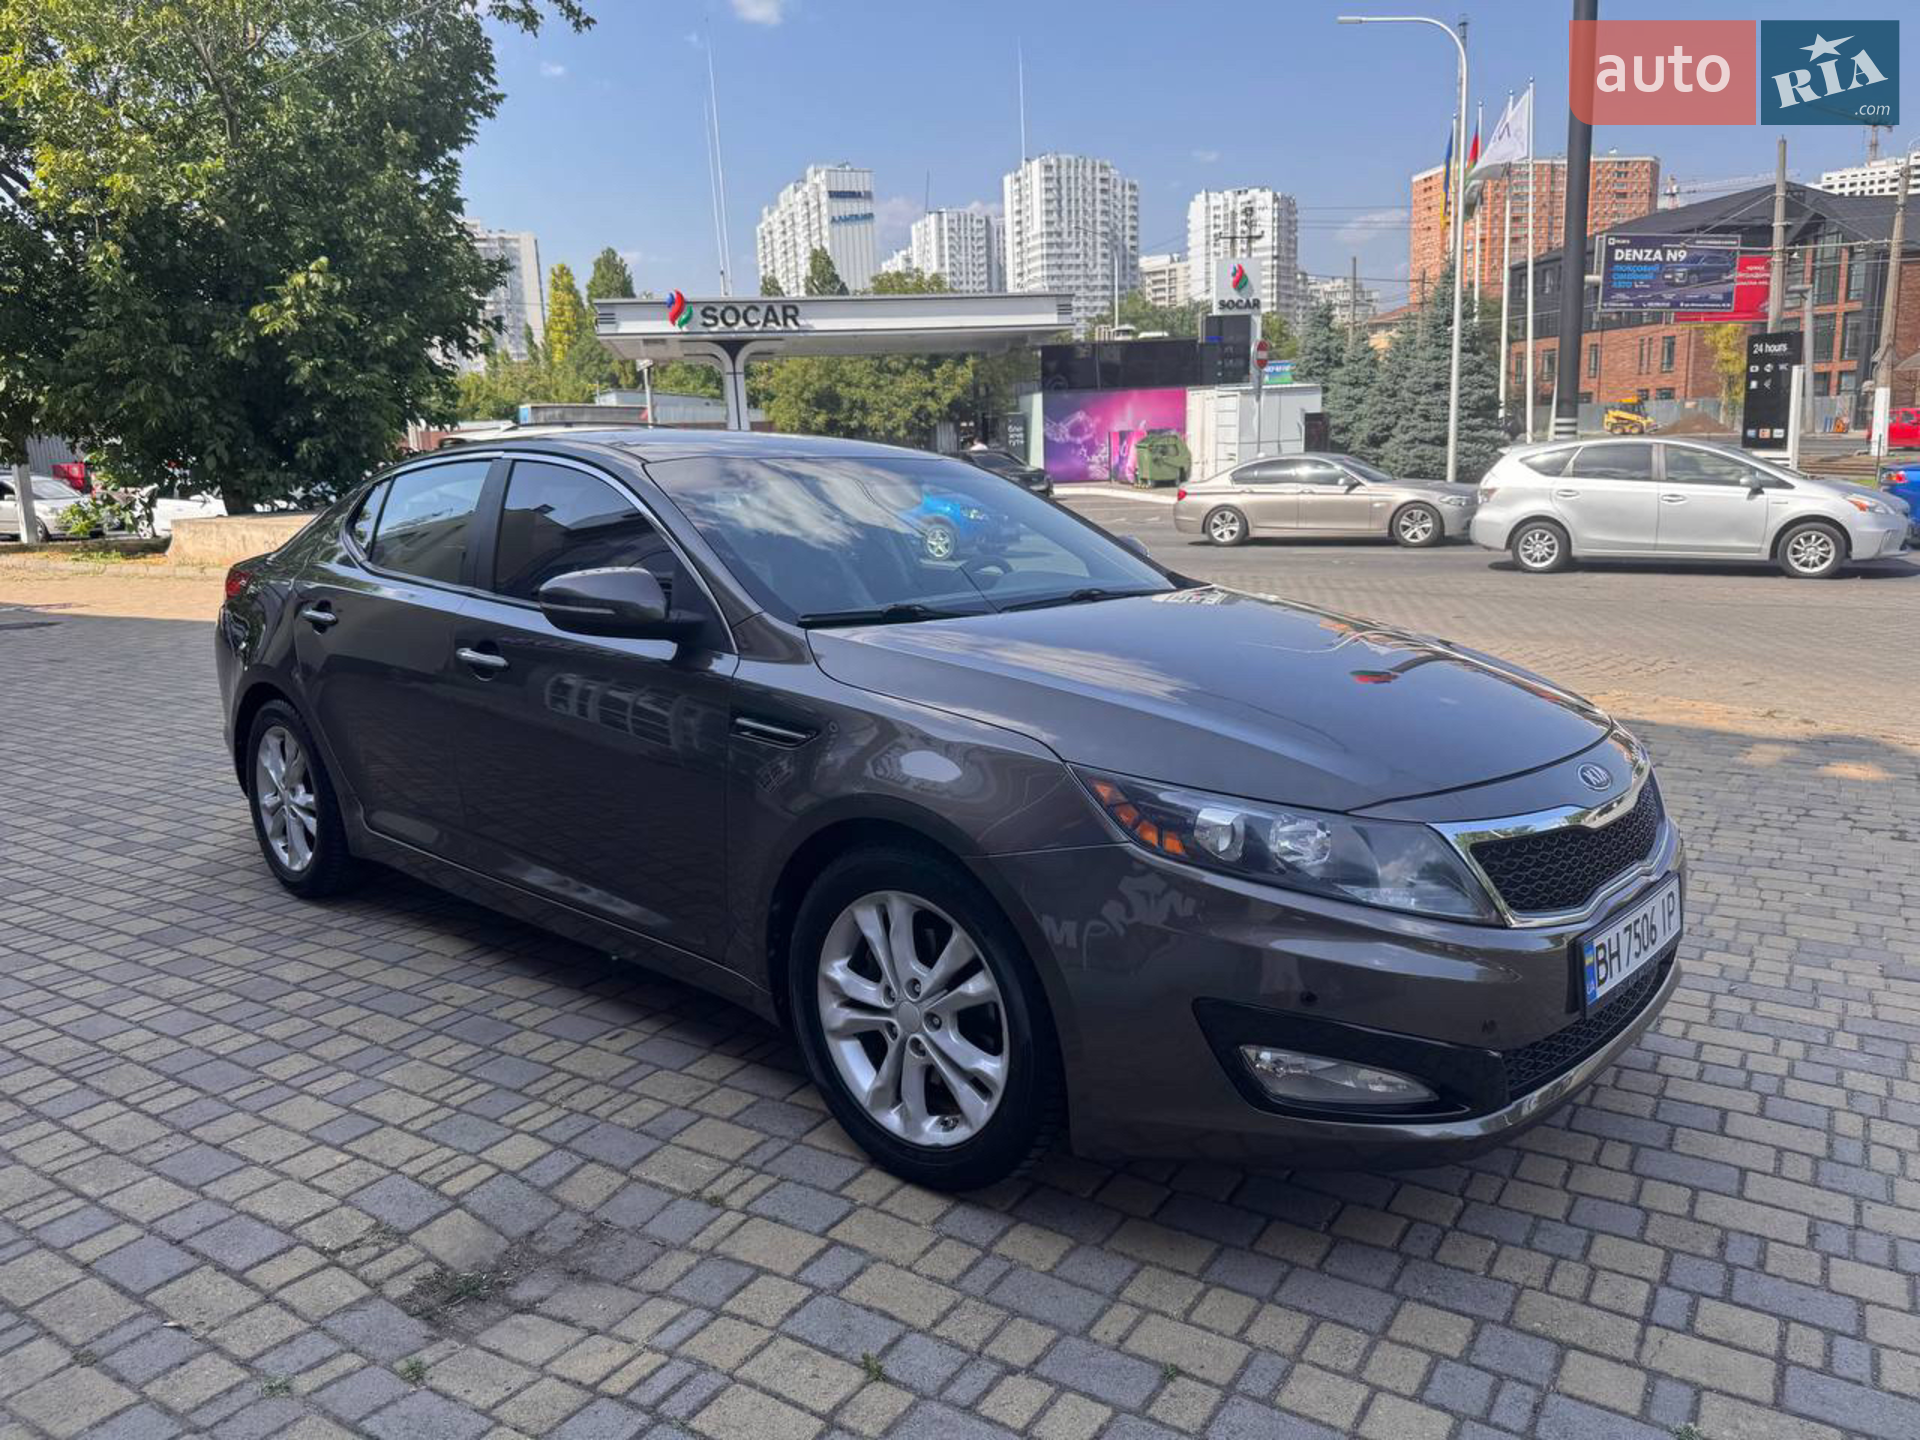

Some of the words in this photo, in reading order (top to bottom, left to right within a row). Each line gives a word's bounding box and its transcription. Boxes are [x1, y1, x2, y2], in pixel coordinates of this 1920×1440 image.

[1614, 248, 1663, 262] DENZA
[1666, 249, 1688, 262] N9
[1218, 298, 1261, 311] SOCAR
[700, 304, 801, 328] SOCAR
[1752, 343, 1763, 355] 24
[1764, 342, 1788, 353] hours
[1595, 932, 1621, 988] BH
[1623, 905, 1657, 969] 7506
[1661, 890, 1675, 936] IP
